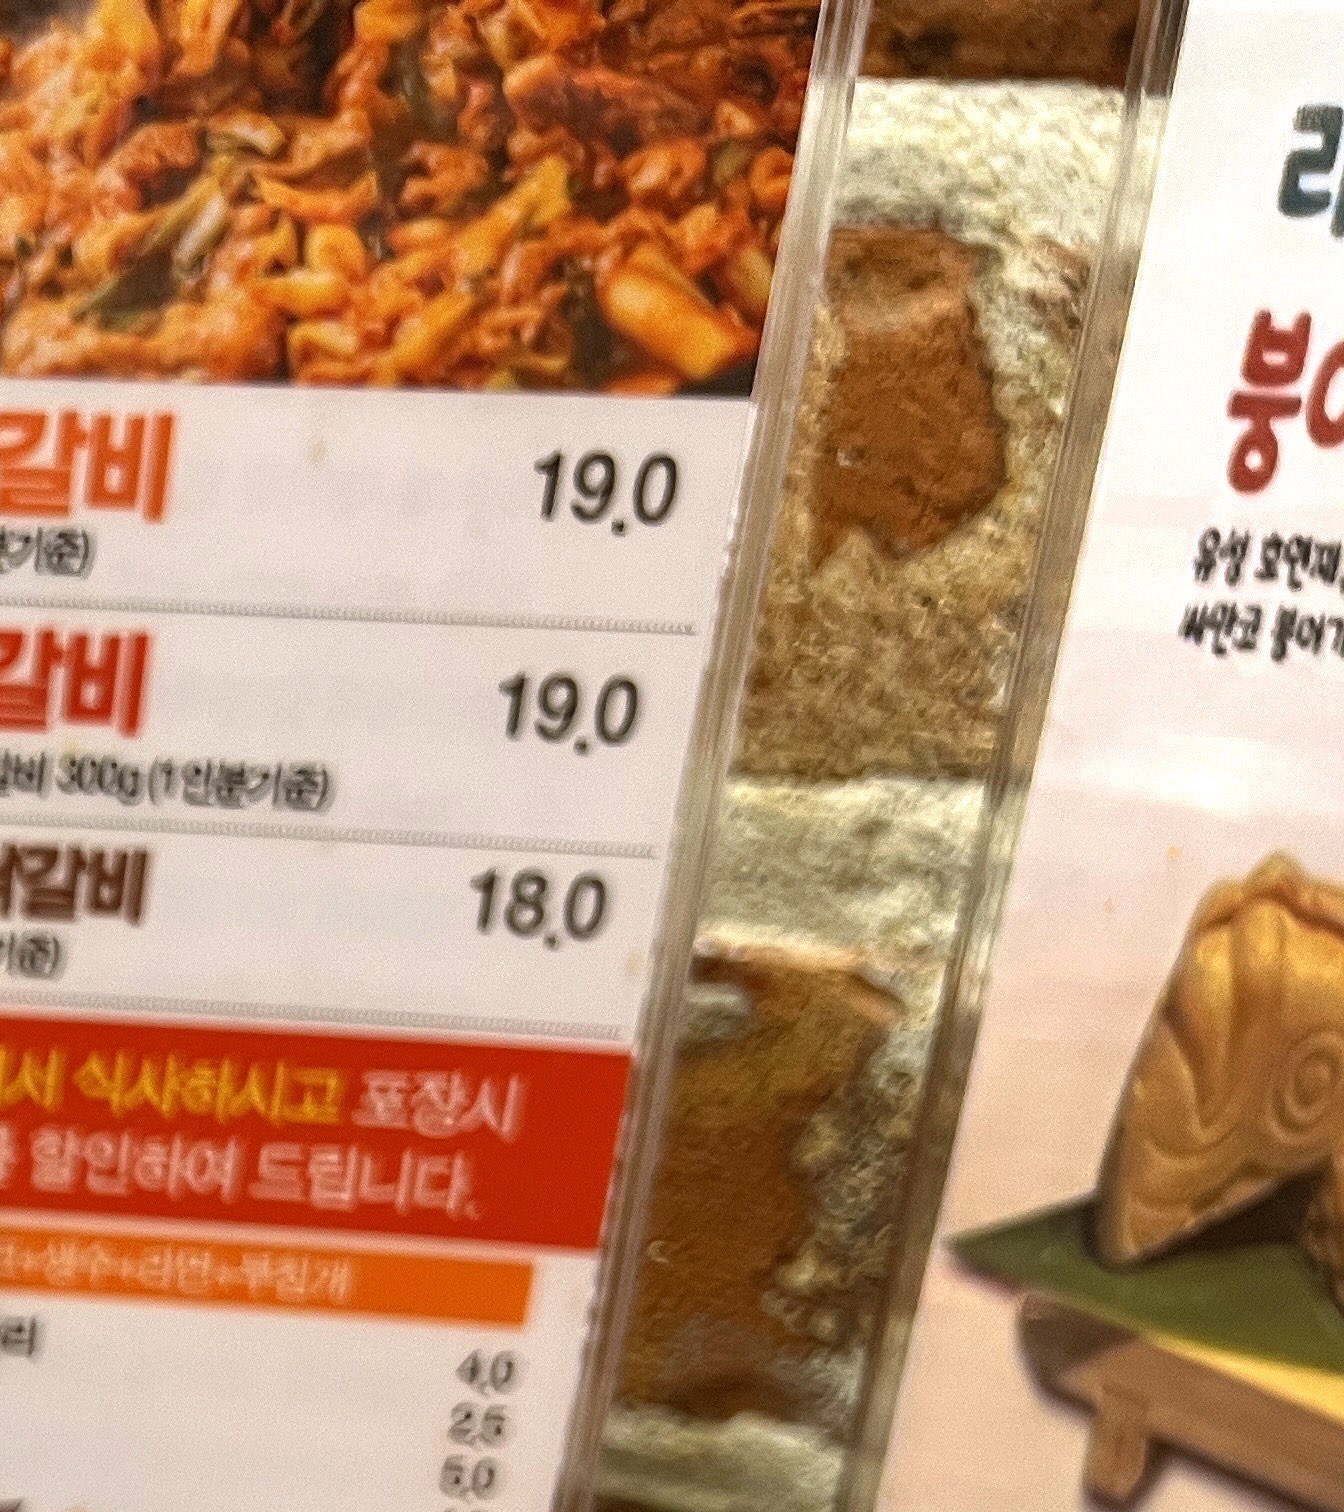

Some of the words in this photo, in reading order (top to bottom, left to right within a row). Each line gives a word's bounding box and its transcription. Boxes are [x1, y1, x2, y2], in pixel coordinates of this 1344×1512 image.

[73, 1050, 344, 1129] 식사하시고
[352, 1068, 524, 1144] 포장시
[30, 1124, 240, 1201] 할인하여
